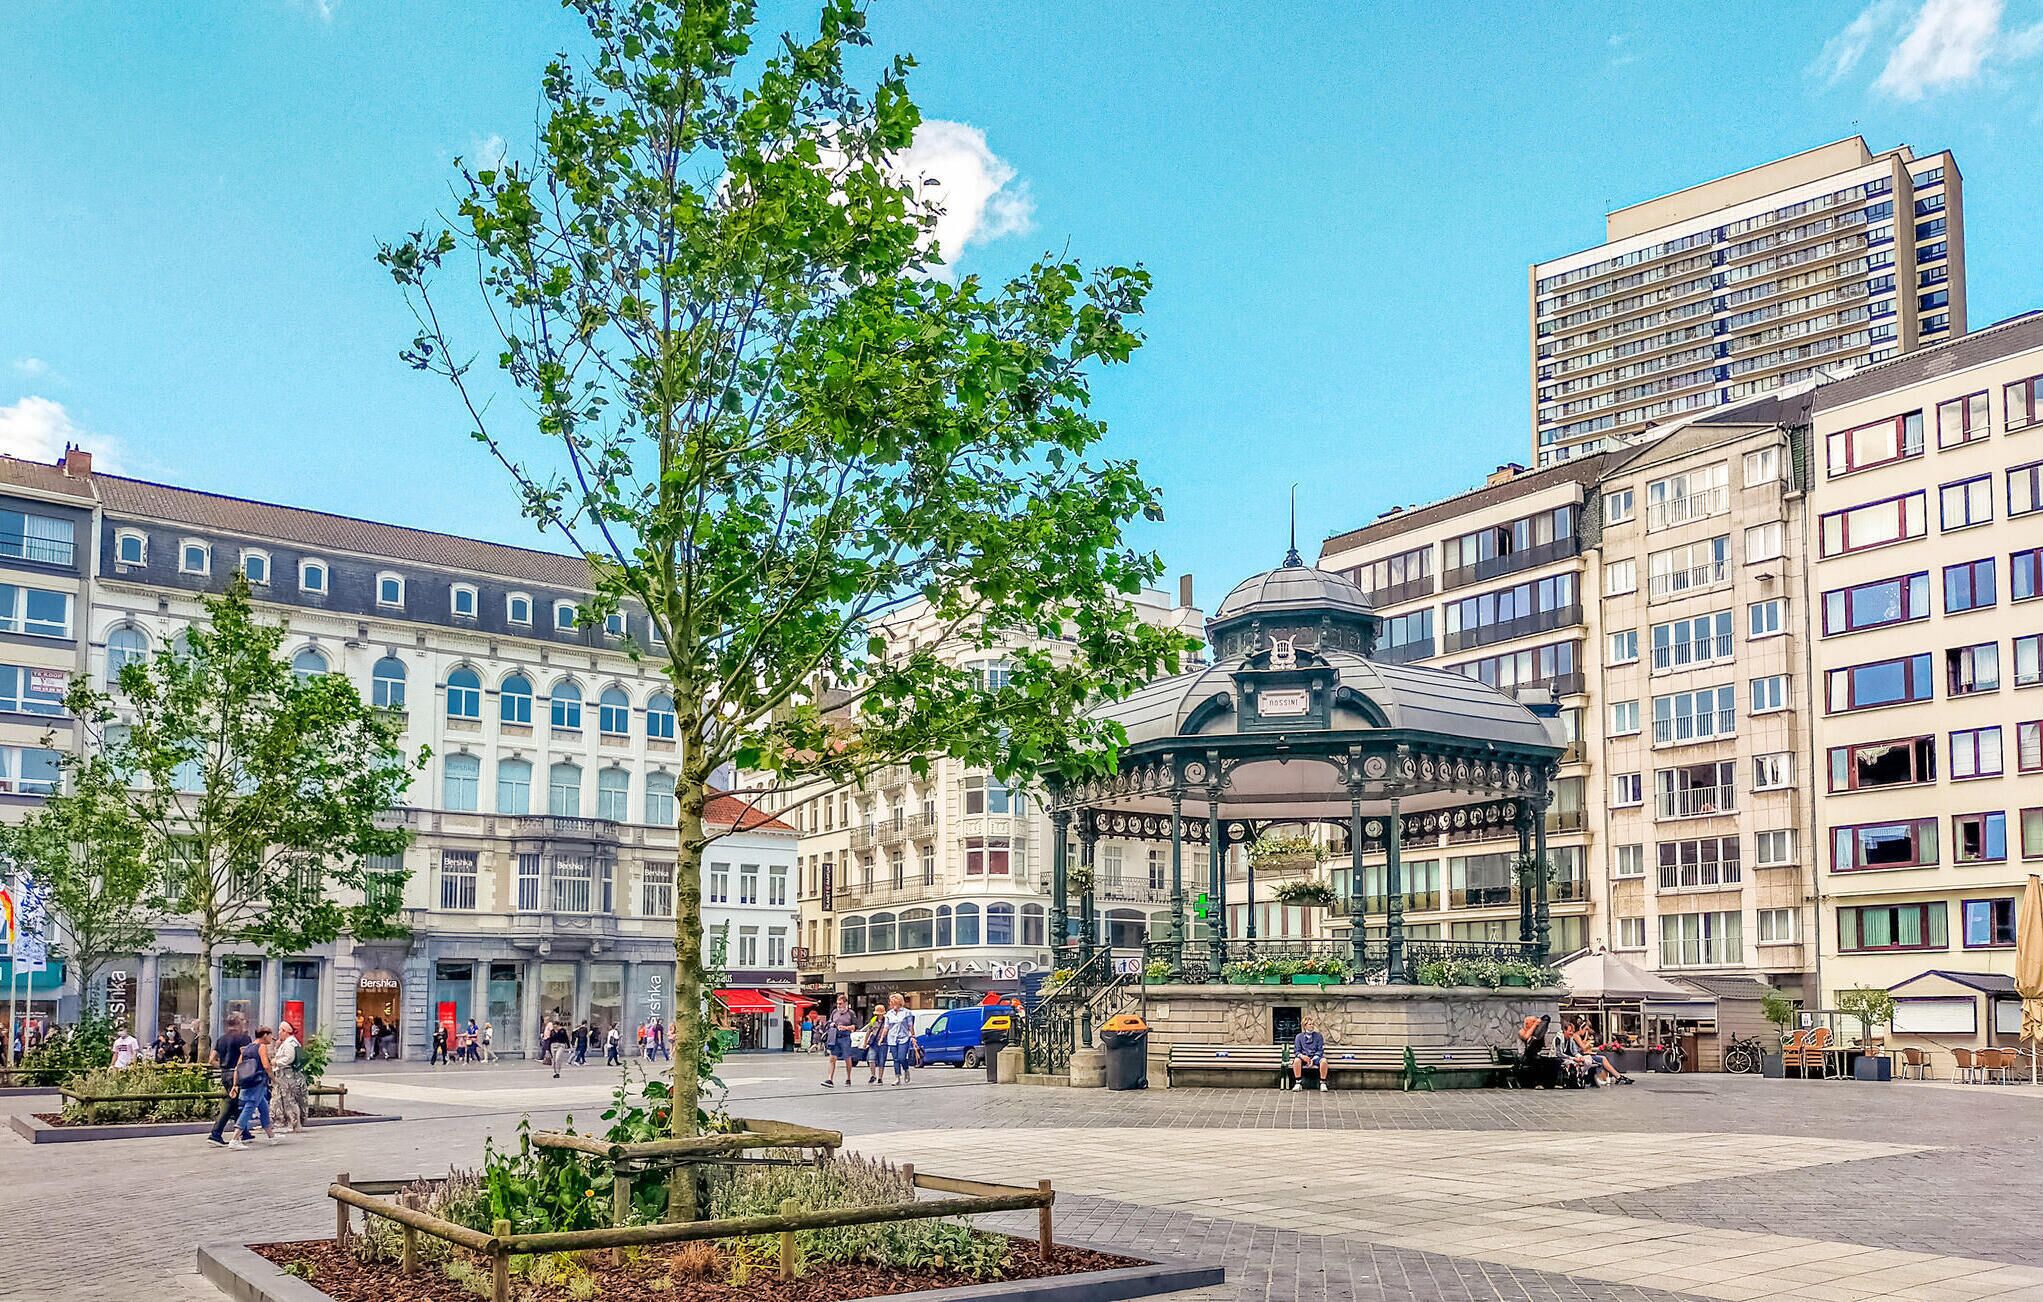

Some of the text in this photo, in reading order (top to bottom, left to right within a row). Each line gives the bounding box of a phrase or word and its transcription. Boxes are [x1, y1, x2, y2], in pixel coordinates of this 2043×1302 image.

[444, 857, 473, 867] Bershka
[557, 861, 584, 871] Bershka
[644, 868, 669, 877] Bershka
[361, 978, 398, 988] Bershka
